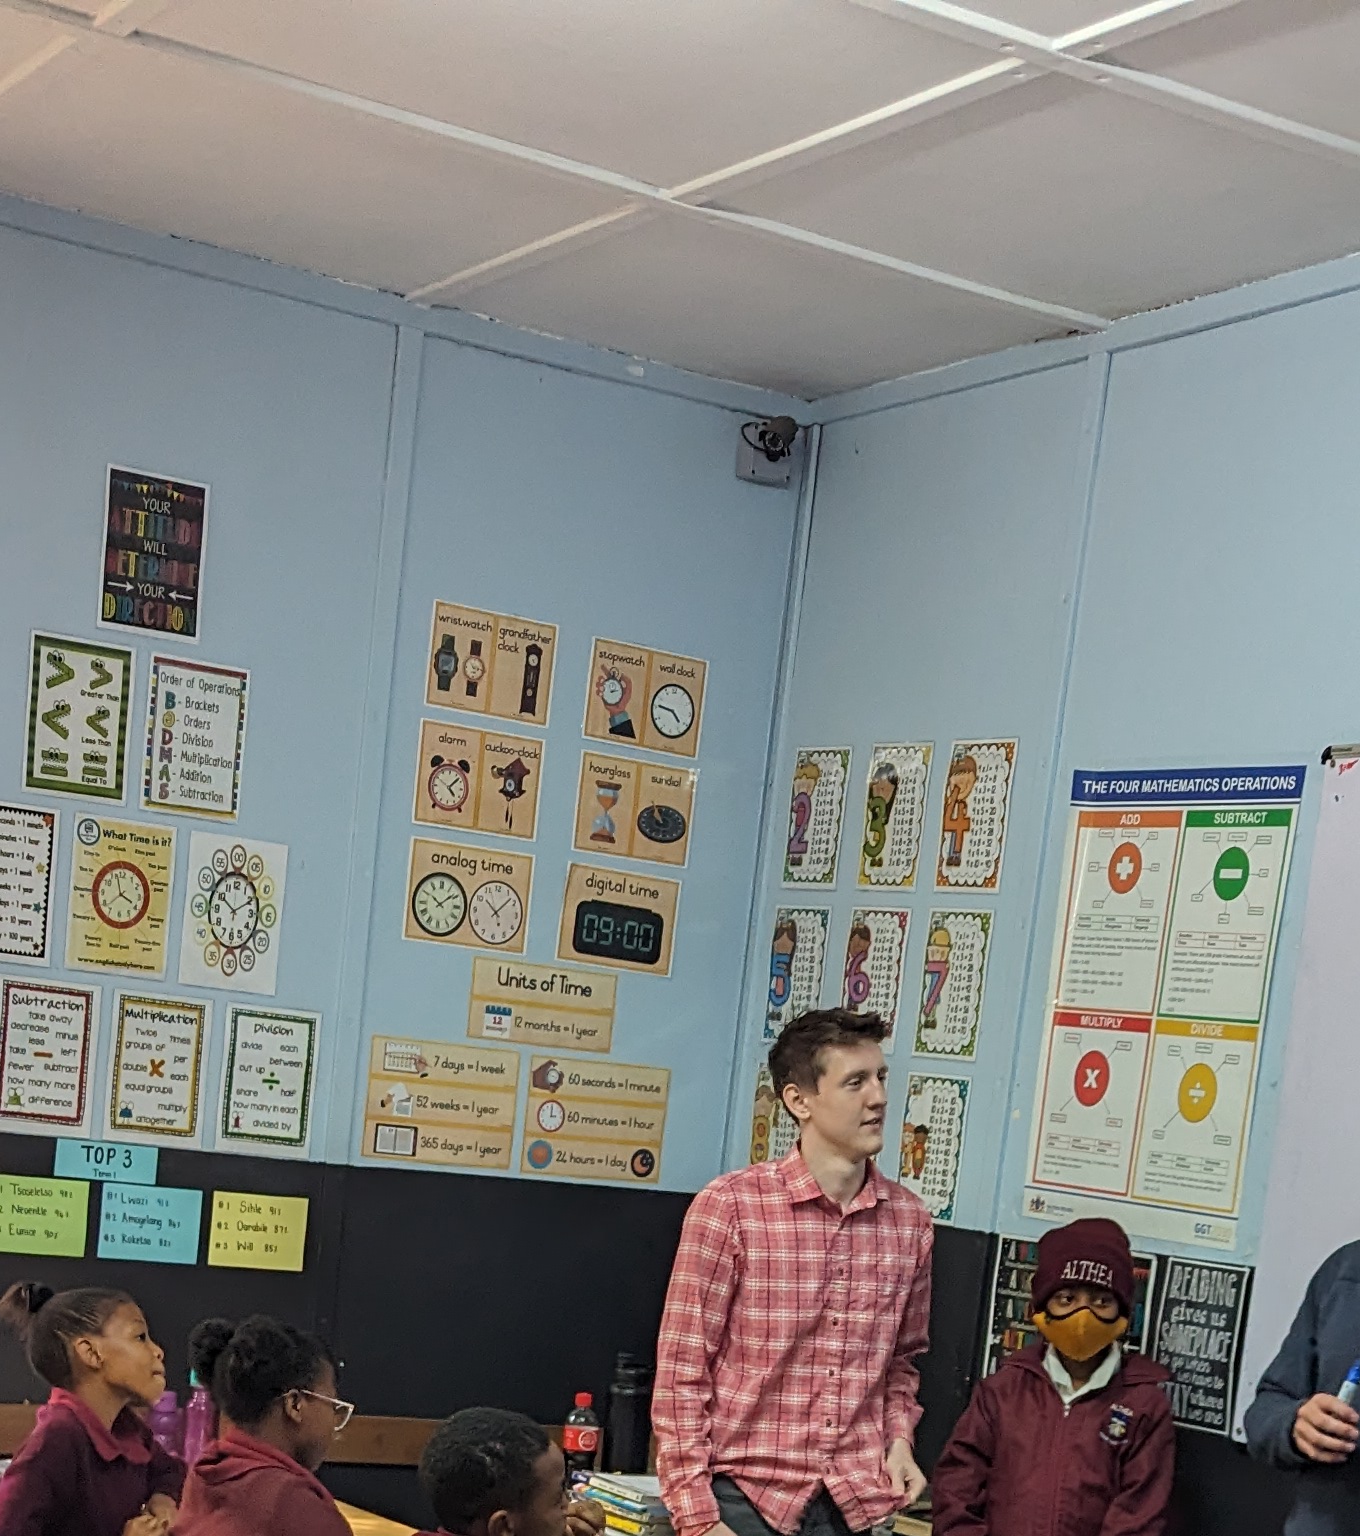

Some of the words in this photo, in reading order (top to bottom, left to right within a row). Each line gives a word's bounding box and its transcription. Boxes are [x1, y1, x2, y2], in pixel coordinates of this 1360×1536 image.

[143, 498, 170, 514] YOUR
[144, 540, 167, 555] WILL
[137, 583, 165, 598] YOUR
[438, 613, 492, 632] wristwatch
[499, 625, 551, 645] grandfather
[498, 641, 520, 655] clock
[598, 650, 645, 668] stopwatch
[660, 663, 676, 675] wall
[676, 665, 696, 679] clock
[160, 672, 182, 687] Order
[187, 676, 195, 688] of
[199, 679, 241, 697] Operations
[185, 697, 219, 714] Brackets
[184, 716, 211, 730] Orders
[182, 733, 213, 748] Division
[439, 733, 467, 747] alarm
[485, 741, 539, 760] cuckoo-clock
[180, 751, 232, 769] Multiplication
[179, 768, 212, 784] Addition
[589, 761, 631, 780] hourglass
[651, 774, 681, 788] sundial
[1082, 780, 1108, 794] THE
[1109, 780, 1140, 793] FOUR
[1142, 777, 1220, 793] MATHEMATICS
[1221, 776, 1296, 791] OPERATIONS
[179, 783, 223, 803] Subtraction
[1120, 814, 1140, 825] ADD
[1214, 812, 1267, 824] SUBTRACT
[103, 829, 127, 841] What
[129, 832, 149, 844] Time
[151, 836, 159, 846] is
[161, 837, 172, 848] it?
[431, 852, 477, 876] analog
[481, 858, 513, 875] time
[585, 873, 626, 896] digital
[629, 882, 659, 899] time
[582, 914, 655, 952] 09:00
[497, 967, 537, 992] Units
[541, 975, 558, 993] of
[560, 976, 592, 998] Time
[12, 993, 84, 1011] Subtraction
[125, 1009, 197, 1027] Multiplication
[514, 1016, 522, 1028] 12
[524, 1017, 561, 1033] months
[576, 1025, 598, 1038] year
[1080, 1015, 1124, 1029] MULTIPLY
[11, 1022, 49, 1034] decrease
[254, 1023, 293, 1036] Division
[1191, 1024, 1223, 1036] DIVIDE
[433, 1055, 440, 1069] 7
[441, 1058, 465, 1075] days
[480, 1064, 505, 1074] week
[81, 1144, 117, 1166] TOP
[123, 1149, 133, 1168] 3
[1061, 1259, 1113, 1288] ALTHEA
[1170, 1265, 1238, 1308] READING
